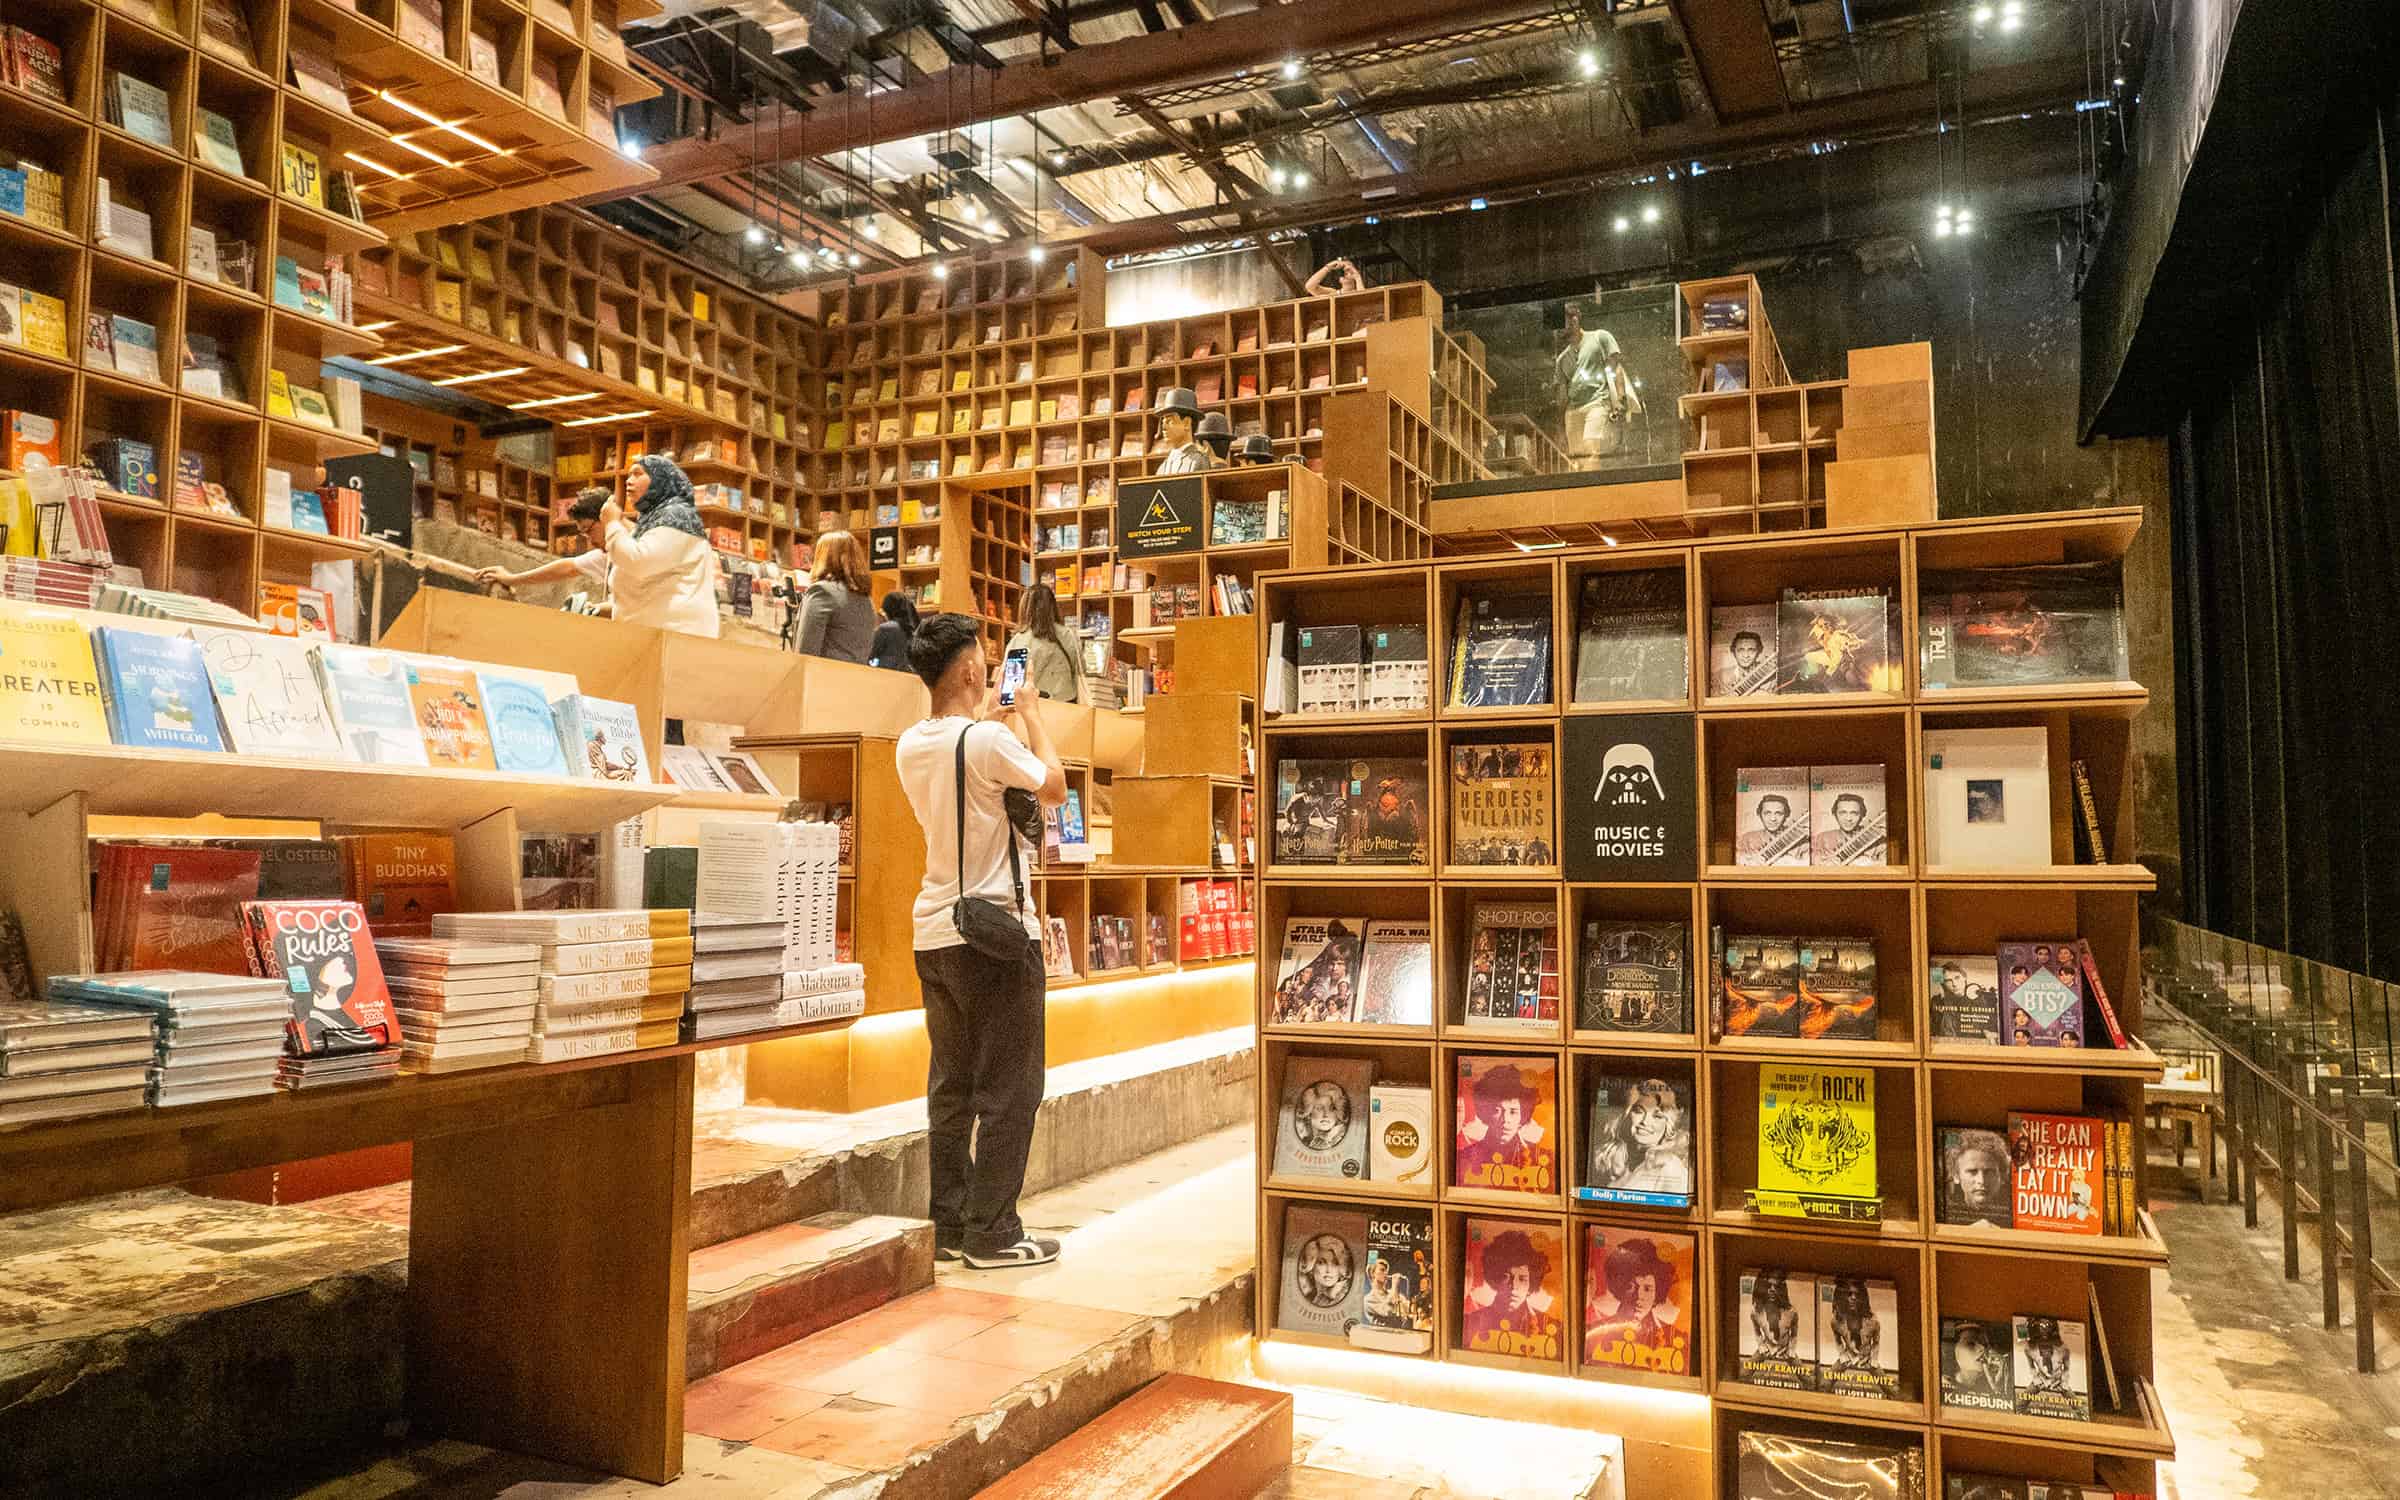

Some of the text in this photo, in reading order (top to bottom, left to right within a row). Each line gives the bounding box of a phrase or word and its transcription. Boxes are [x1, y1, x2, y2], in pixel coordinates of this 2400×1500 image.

[1152, 528, 1171, 536] YOUR
[1929, 625, 1946, 662] TRUE
[0, 674, 97, 697] REATER
[20, 718, 80, 728] COMING
[1460, 789, 1534, 808] HEROES
[1461, 808, 1544, 828] VILLAINS
[1595, 827, 1649, 840] MUSIC
[393, 847, 426, 859] TINY
[1353, 837, 1375, 852] Harry
[1375, 836, 1399, 850] Potter
[1597, 843, 1663, 856] MOVIES
[286, 850, 336, 862] OSTEEN
[375, 863, 448, 878] BUDDHA'S
[792, 861, 806, 945] Madonna
[810, 861, 824, 944] Madonna
[825, 861, 838, 943] Madonna
[276, 909, 363, 934] COCO
[1291, 925, 1327, 934] STAR
[1290, 934, 1327, 943] WARS
[1373, 928, 1406, 936] STAR
[285, 931, 353, 964] Rules
[799, 972, 850, 992] Madonna
[799, 999, 851, 1018] Madonna
[2023, 991, 2067, 1013] BTS?
[1822, 1075, 1865, 1102] ROCK
[1385, 1135, 1417, 1147] ROCK
[2019, 1120, 2091, 1147] SHE CAN
[2036, 1146, 2095, 1171] REALLY
[2017, 1167, 2070, 1193] LAY IT
[1592, 1190, 1647, 1202] Dolly Parton
[1812, 1202, 1840, 1214] ROCK
[2017, 1192, 2068, 1219] DOWN
[1370, 1221, 1411, 1236] ROCK
[1743, 1360, 1812, 1376] LENNY KRAVITZ
[1823, 1369, 1895, 1386] LENNY KRAVITZ
[1943, 1392, 2014, 1411] K.HEPBURN
[2018, 1392, 2083, 1406] LENNY KRAVITZ
